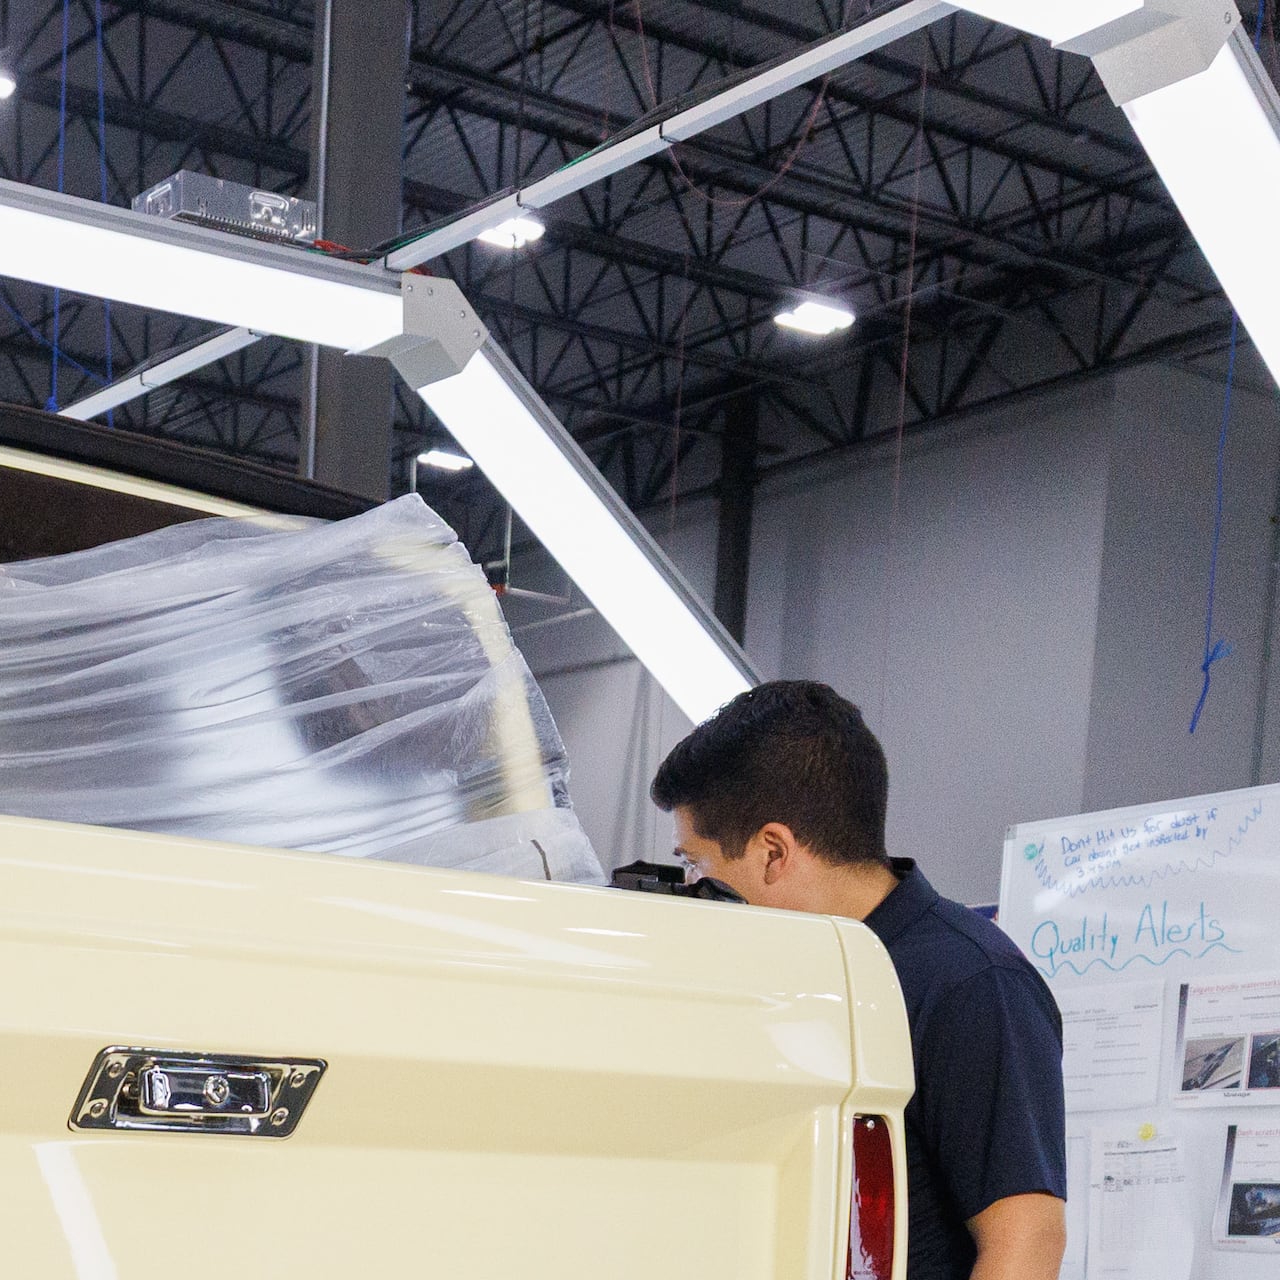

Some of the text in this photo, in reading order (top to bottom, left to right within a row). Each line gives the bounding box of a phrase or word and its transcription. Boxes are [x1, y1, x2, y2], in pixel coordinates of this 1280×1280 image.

[1170, 811, 1200, 829] dust
[1032, 900, 1225, 971] Quality Alerts
